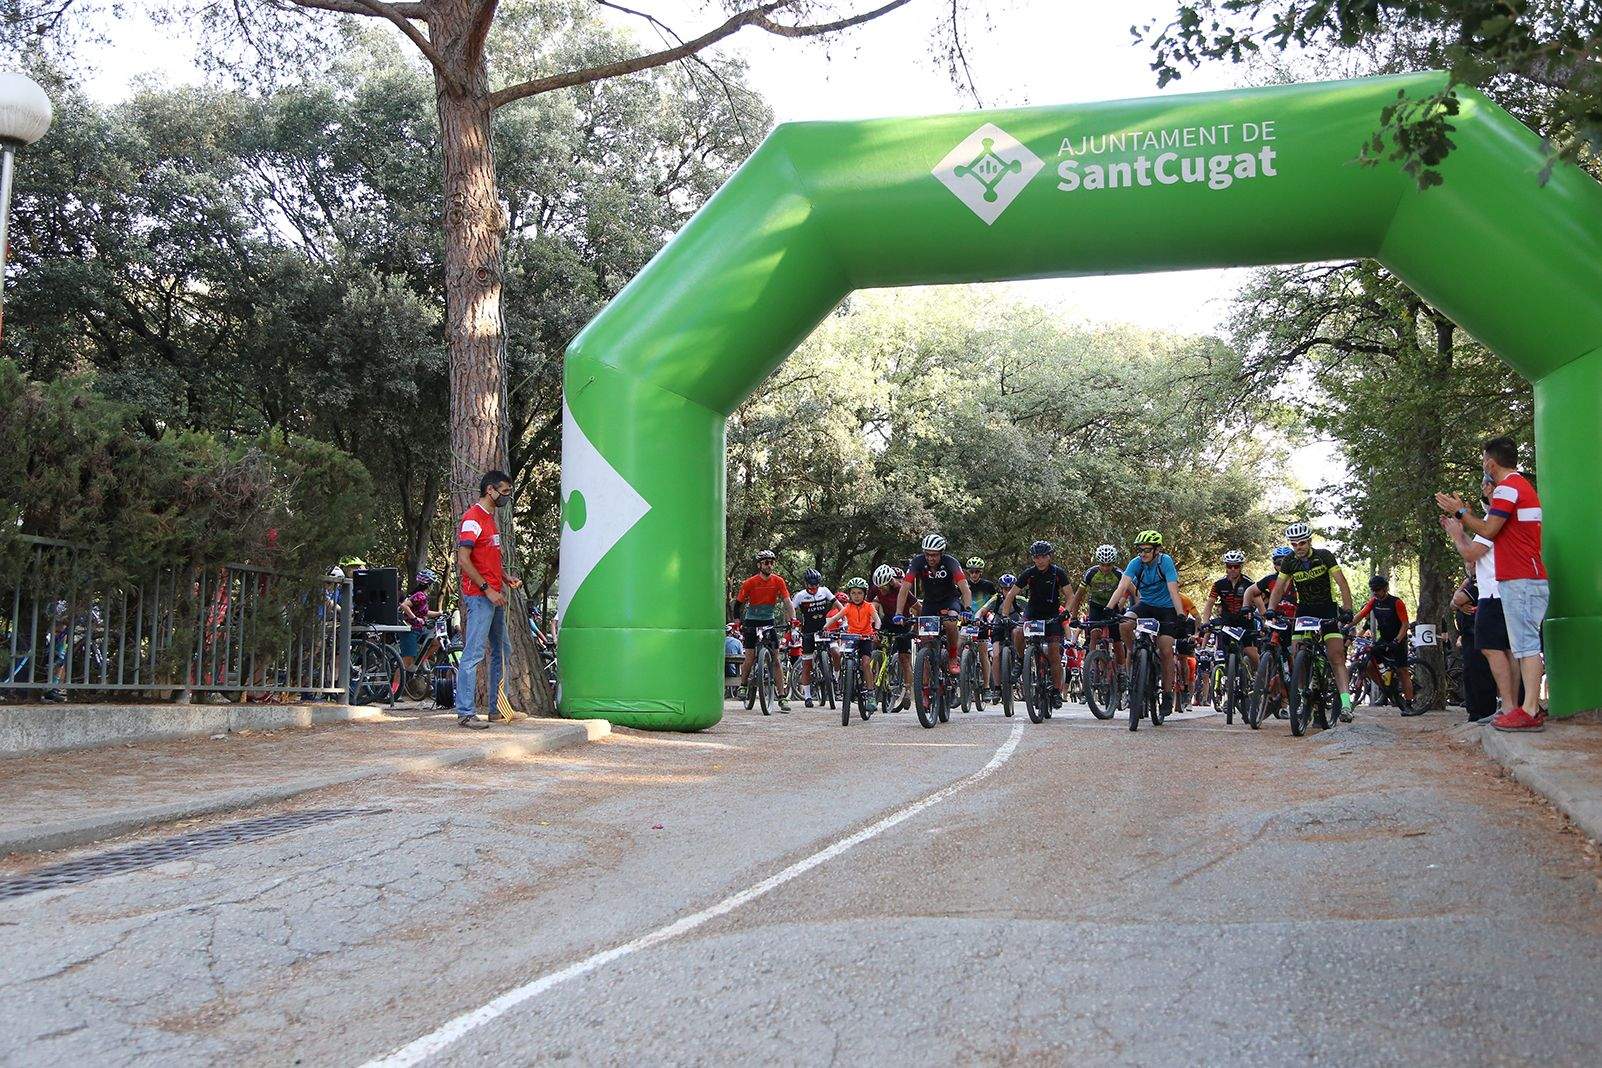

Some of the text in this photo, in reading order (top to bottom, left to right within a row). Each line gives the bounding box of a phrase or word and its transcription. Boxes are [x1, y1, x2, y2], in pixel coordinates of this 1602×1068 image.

[1057, 121, 1276, 157] AJUNTAMENT DE
[1057, 146, 1278, 192] SantCugat
[1421, 629, 1434, 644] G
